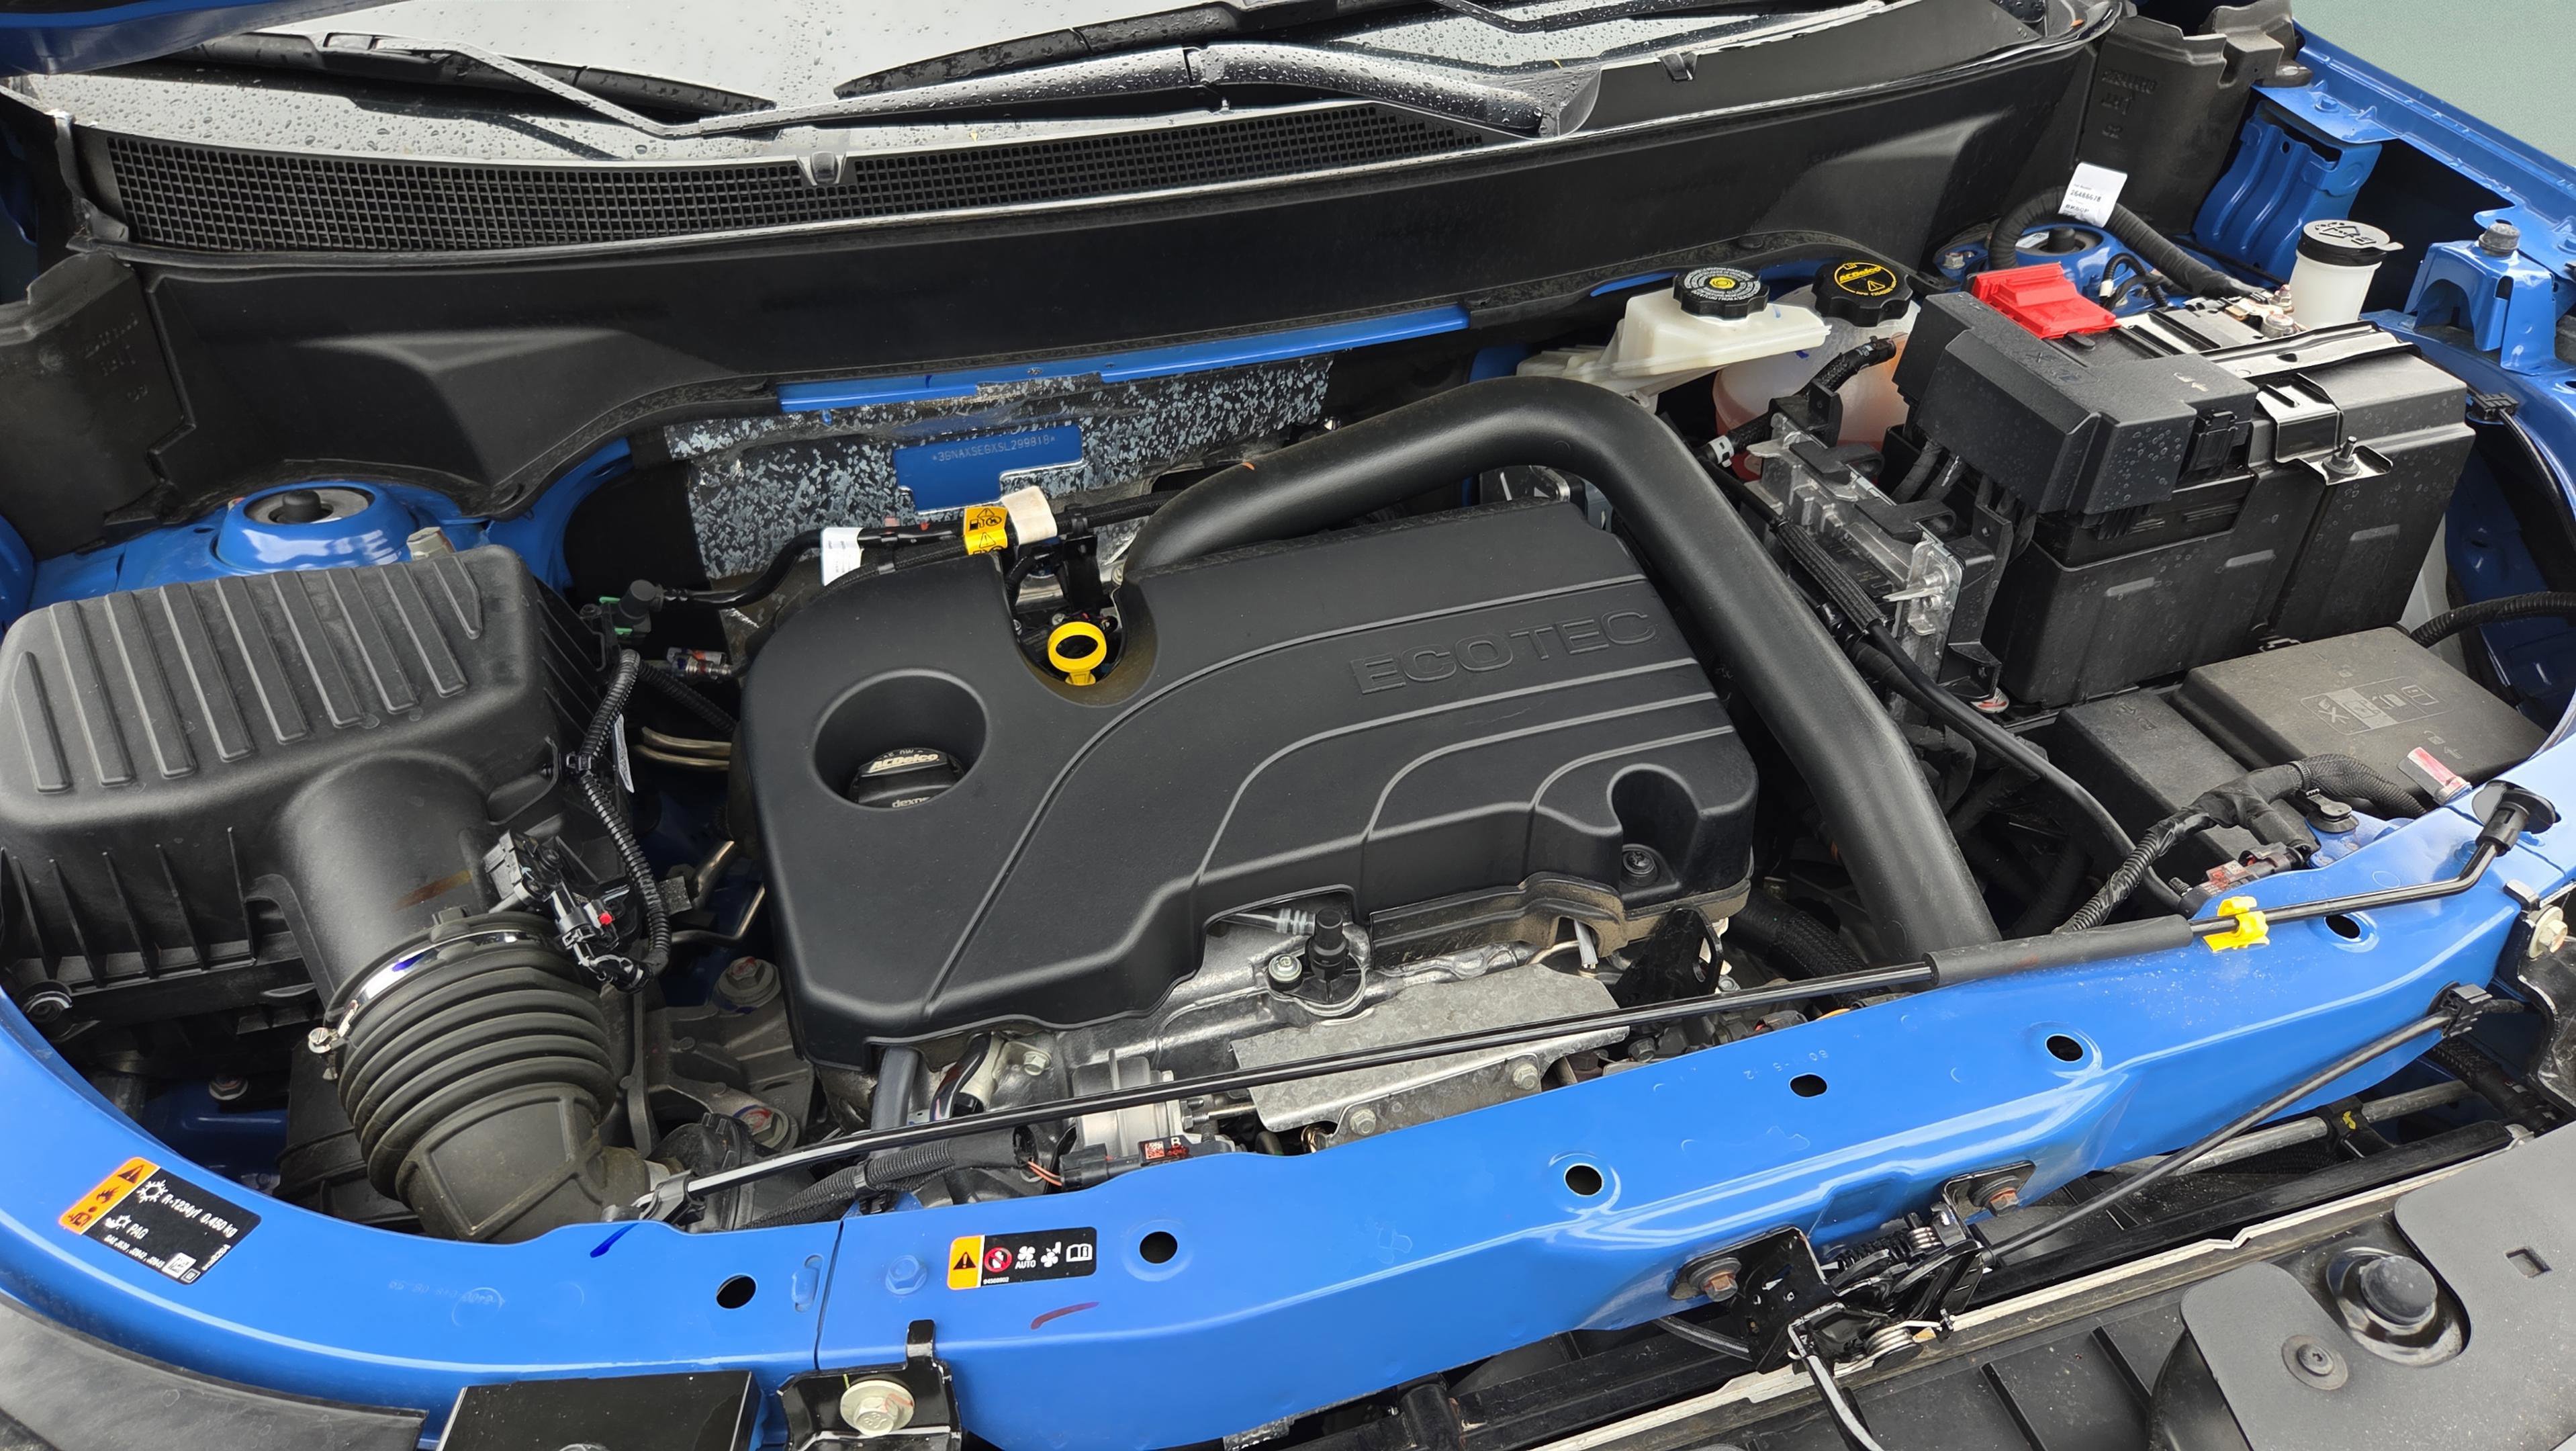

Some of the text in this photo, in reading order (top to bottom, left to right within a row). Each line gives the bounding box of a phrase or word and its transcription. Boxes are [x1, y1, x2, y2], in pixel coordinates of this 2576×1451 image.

[1350, 607, 1656, 693] ECOTEC
[868, 753, 939, 773] ACDelco
[126, 1223, 149, 1240] PAG
[223, 1225, 238, 1238] kg
[1015, 1260, 1036, 1270] AUTO
